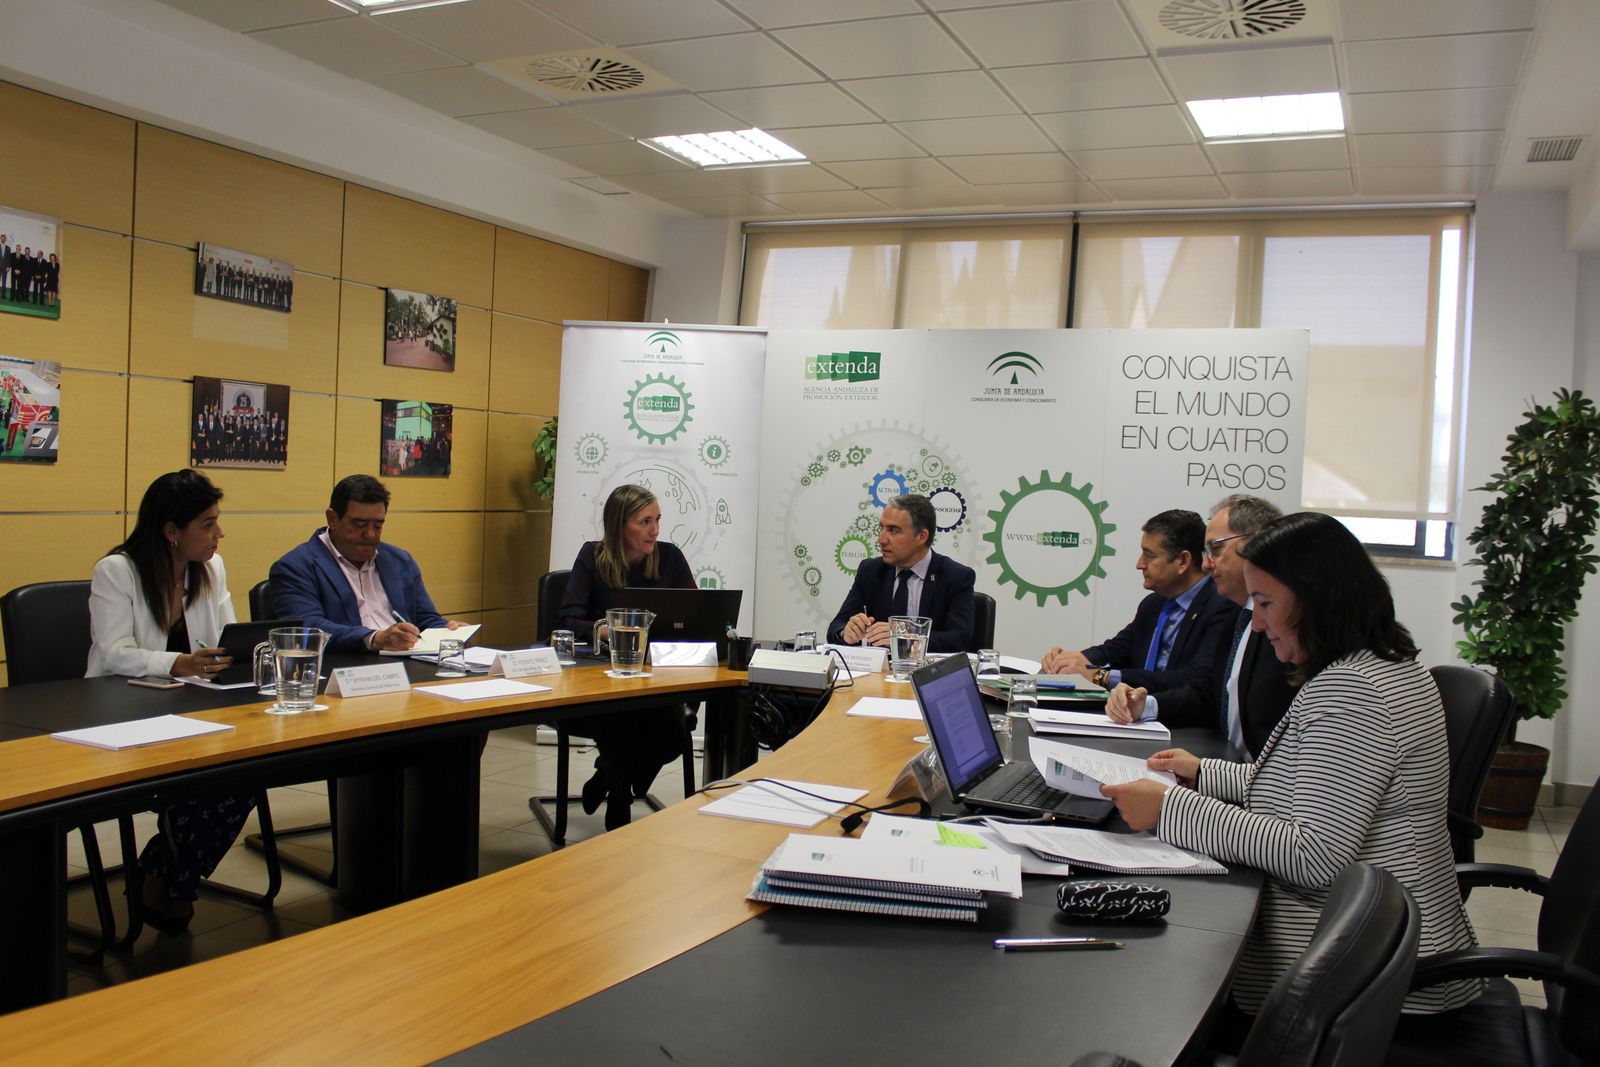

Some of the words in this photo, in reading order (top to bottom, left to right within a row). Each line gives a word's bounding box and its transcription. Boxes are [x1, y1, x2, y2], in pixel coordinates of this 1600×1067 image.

[807, 356, 878, 374] extenda
[1122, 355, 1293, 381] CONQUISTA
[639, 398, 679, 409] extenda
[1135, 390, 1168, 415] EL
[1176, 391, 1290, 418] MUNDO
[1121, 425, 1158, 450] EN
[1167, 425, 1289, 454] CUATRO
[1187, 462, 1286, 491] PASOS
[1006, 533, 1093, 545] www.extenda.es
[382, 672, 400, 680] CAMPO
